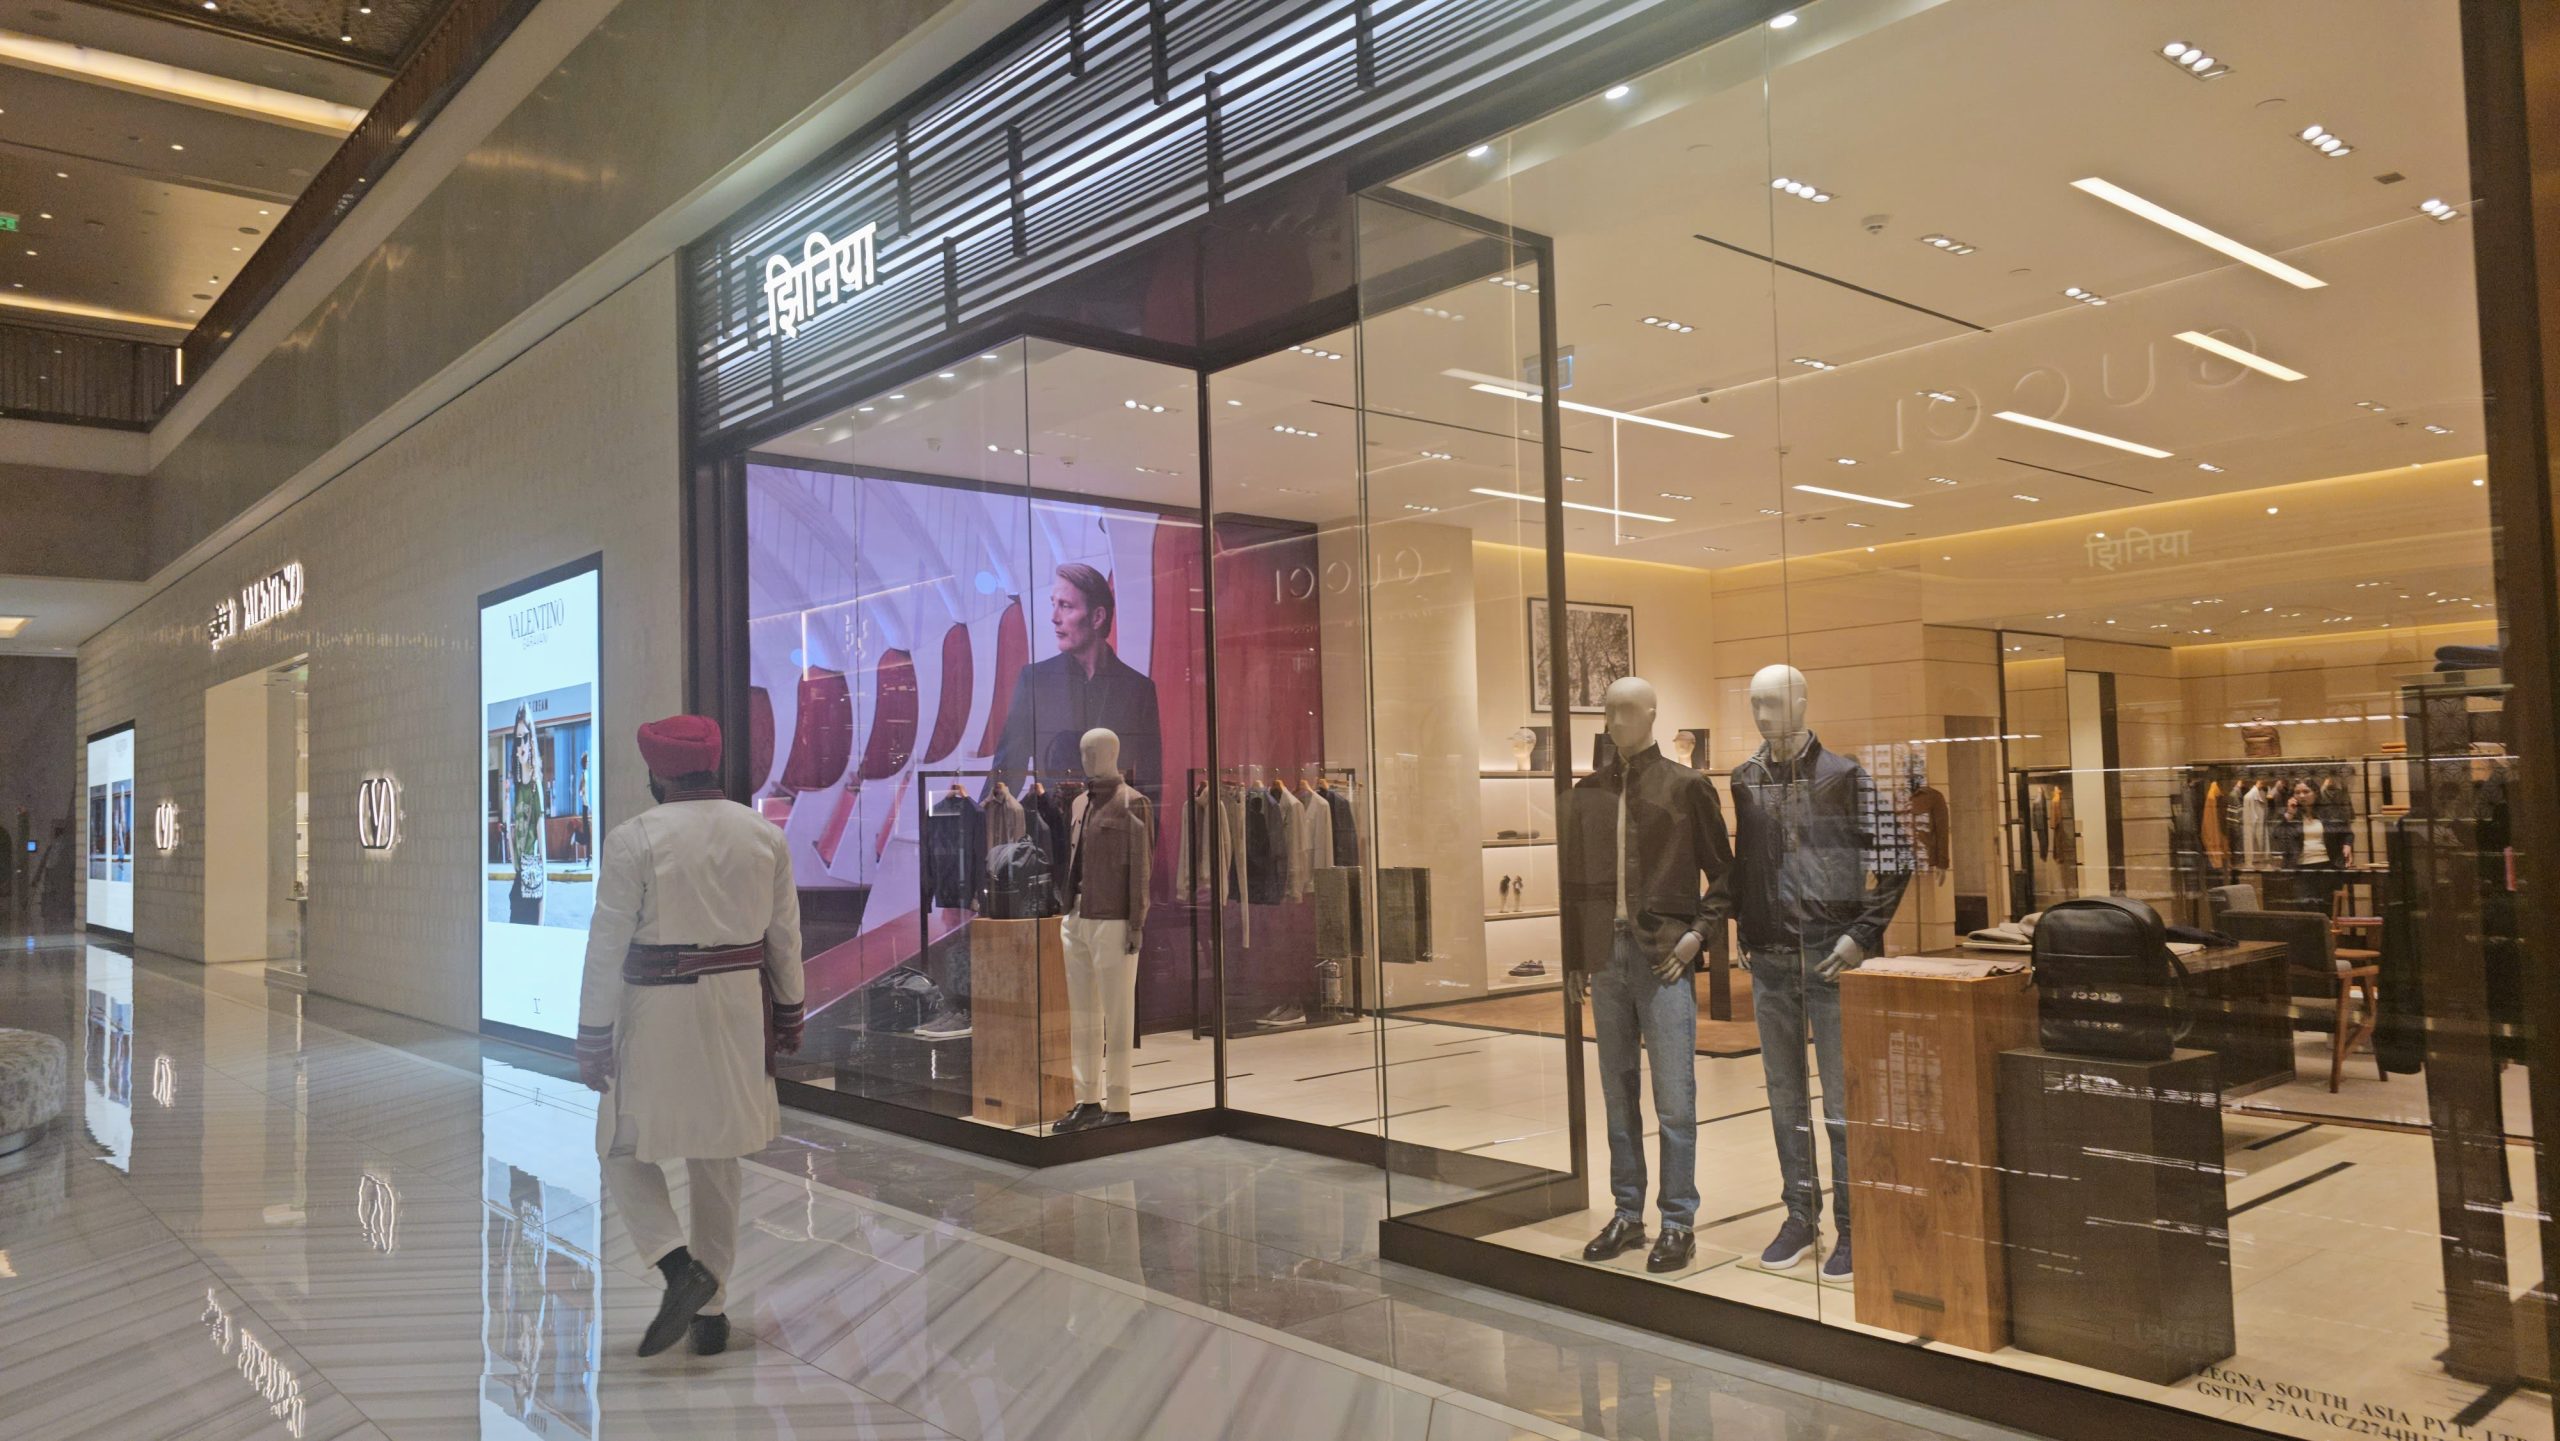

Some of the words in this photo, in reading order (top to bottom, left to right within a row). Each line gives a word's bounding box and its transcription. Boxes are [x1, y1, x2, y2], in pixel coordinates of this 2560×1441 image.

[764, 222, 877, 339] झिनिया
[2083, 526, 2193, 572] झिनिया
[508, 598, 565, 639] VALENTINO
[2196, 1381, 2257, 1407] GSTIN
[2275, 1382, 2348, 1411] SOUTH
[2360, 1403, 2412, 1426] ASIA
